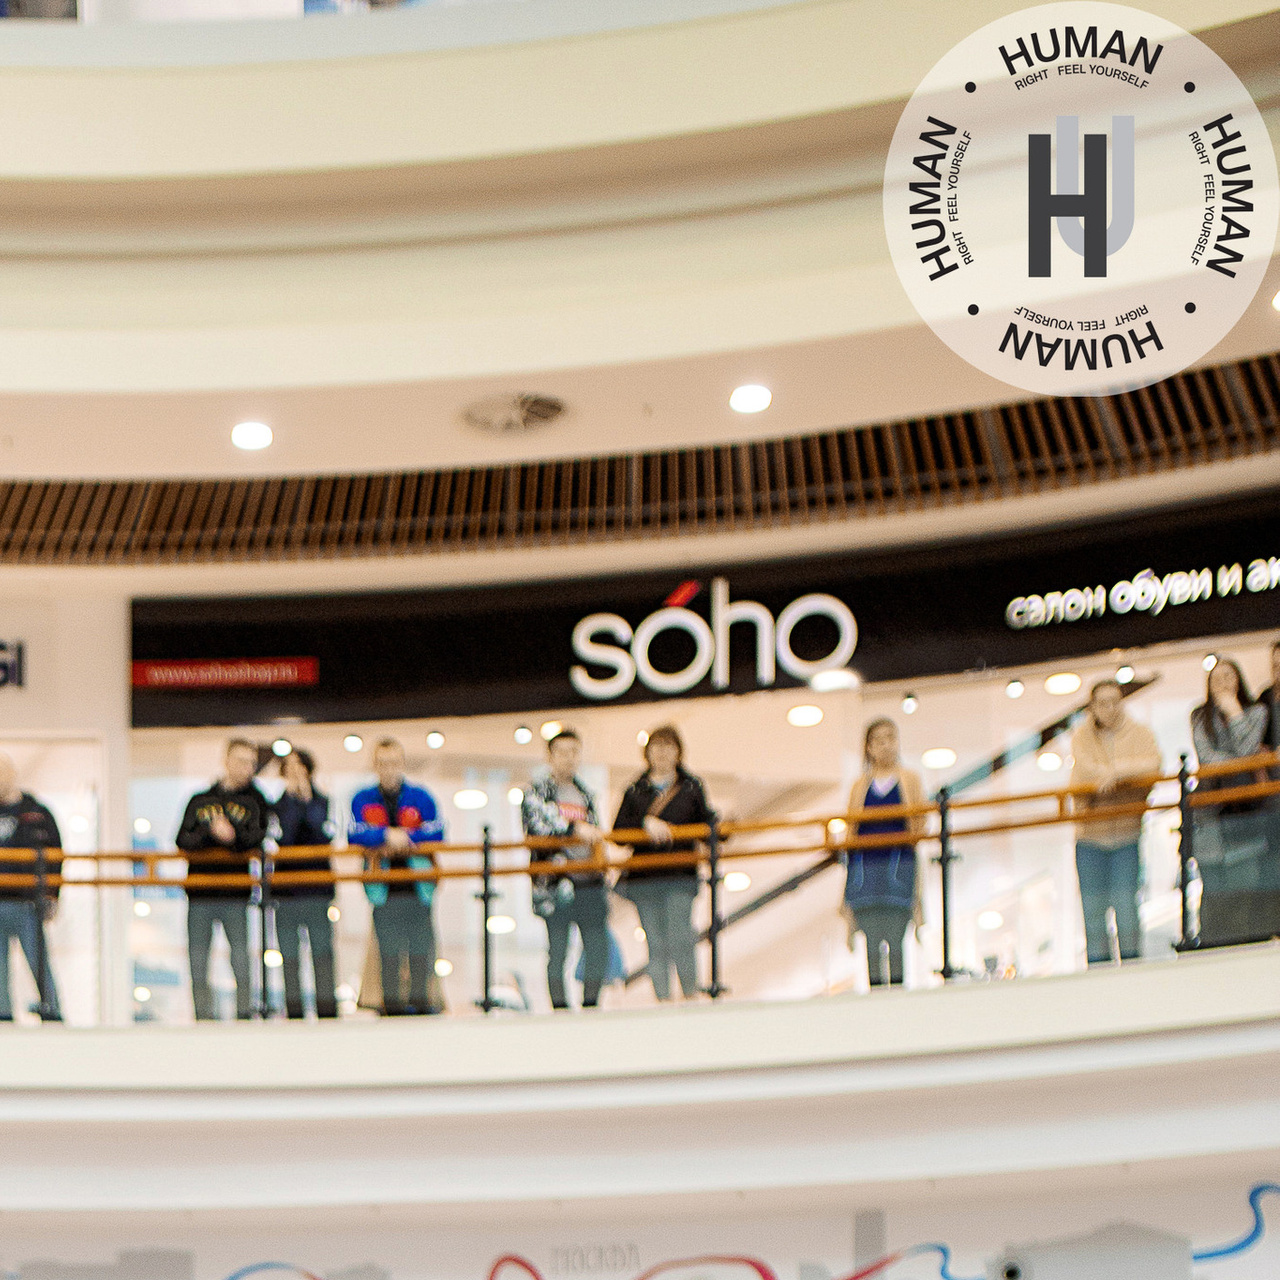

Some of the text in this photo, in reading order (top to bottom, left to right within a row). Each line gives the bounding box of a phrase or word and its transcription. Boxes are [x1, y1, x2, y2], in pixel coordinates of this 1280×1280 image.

[1005, 584, 1107, 630] салон
[1109, 568, 1213, 617] обуви
[1216, 562, 1243, 598] и
